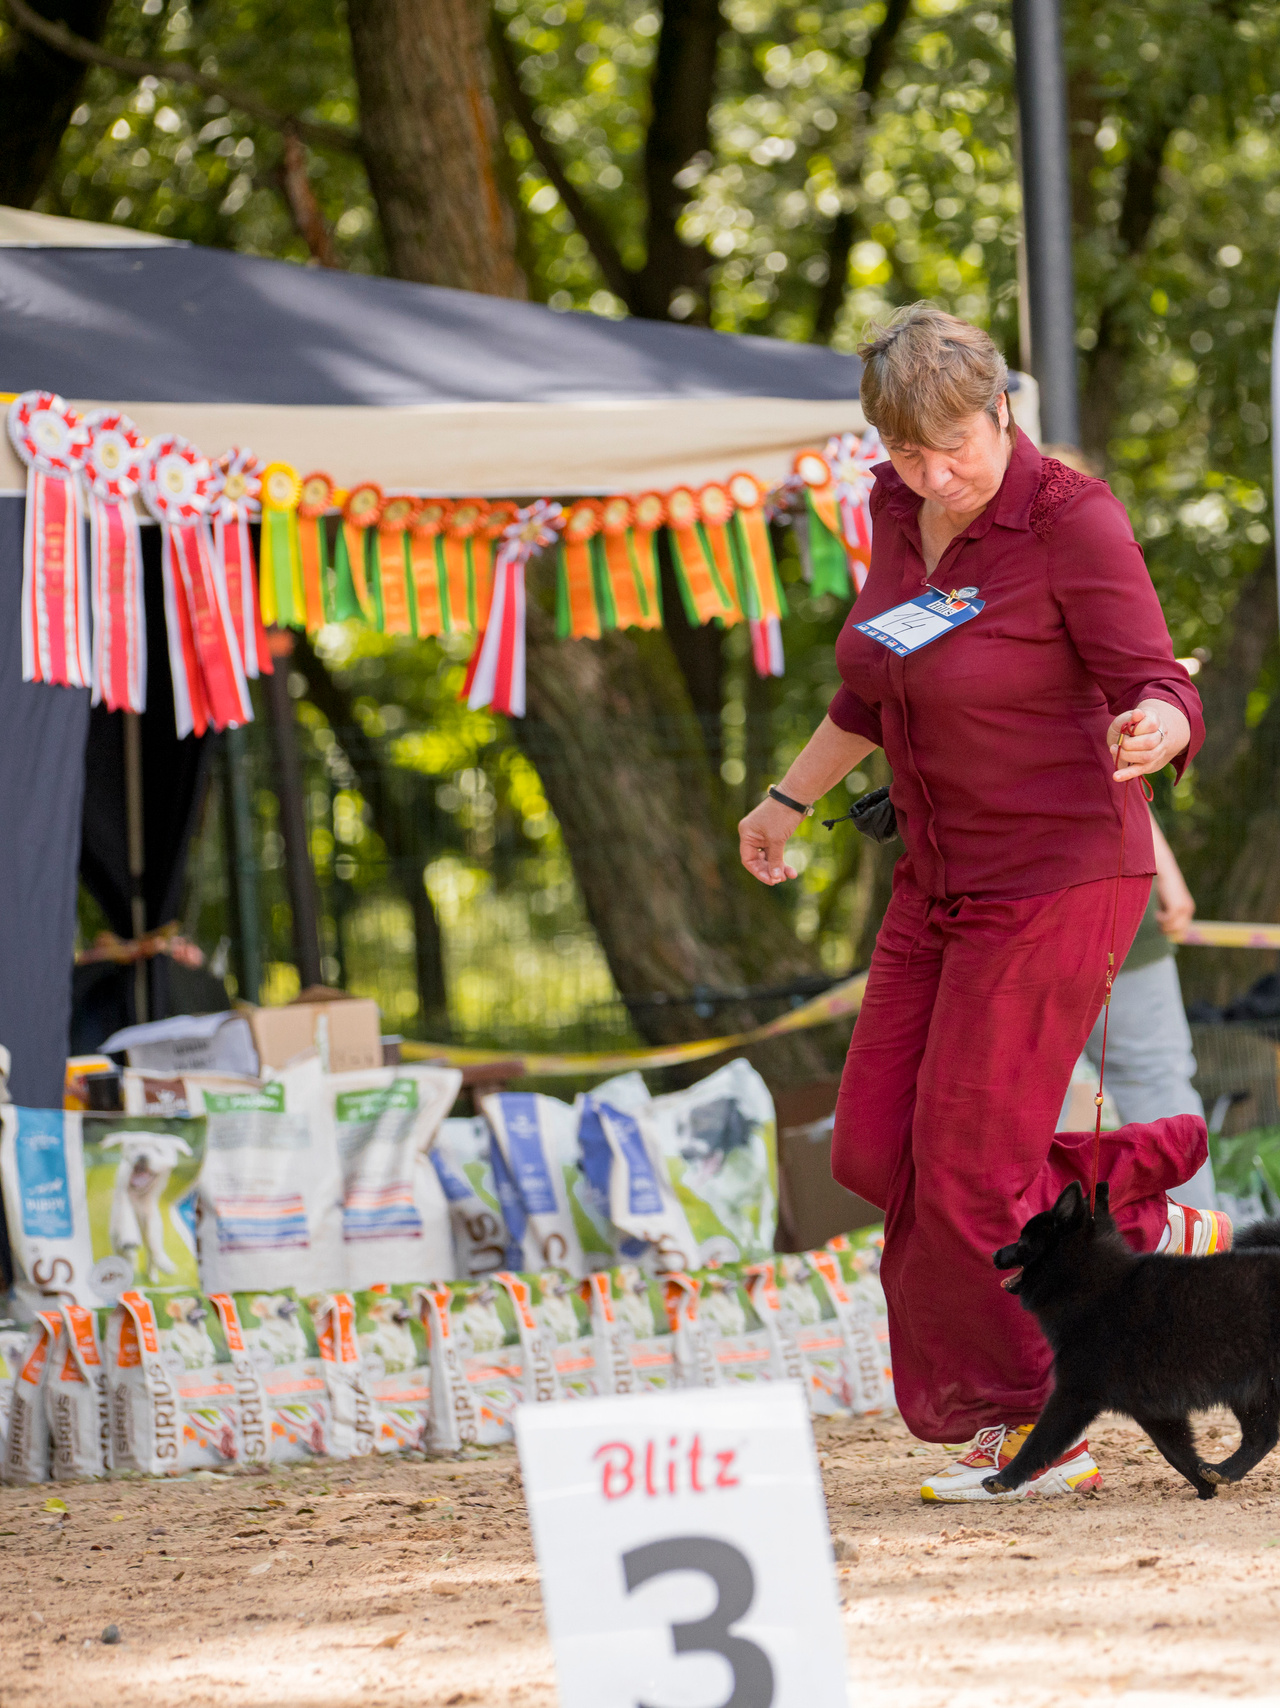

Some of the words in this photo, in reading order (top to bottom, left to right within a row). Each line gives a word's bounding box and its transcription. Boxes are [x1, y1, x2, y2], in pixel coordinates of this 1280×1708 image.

[57, 1392, 74, 1465] SIRIUS
[149, 1362, 179, 1460] SIRIUS
[234, 1360, 267, 1457] SIRIUS
[594, 1435, 741, 1500] Blitz
[621, 1535, 775, 1708] 3
